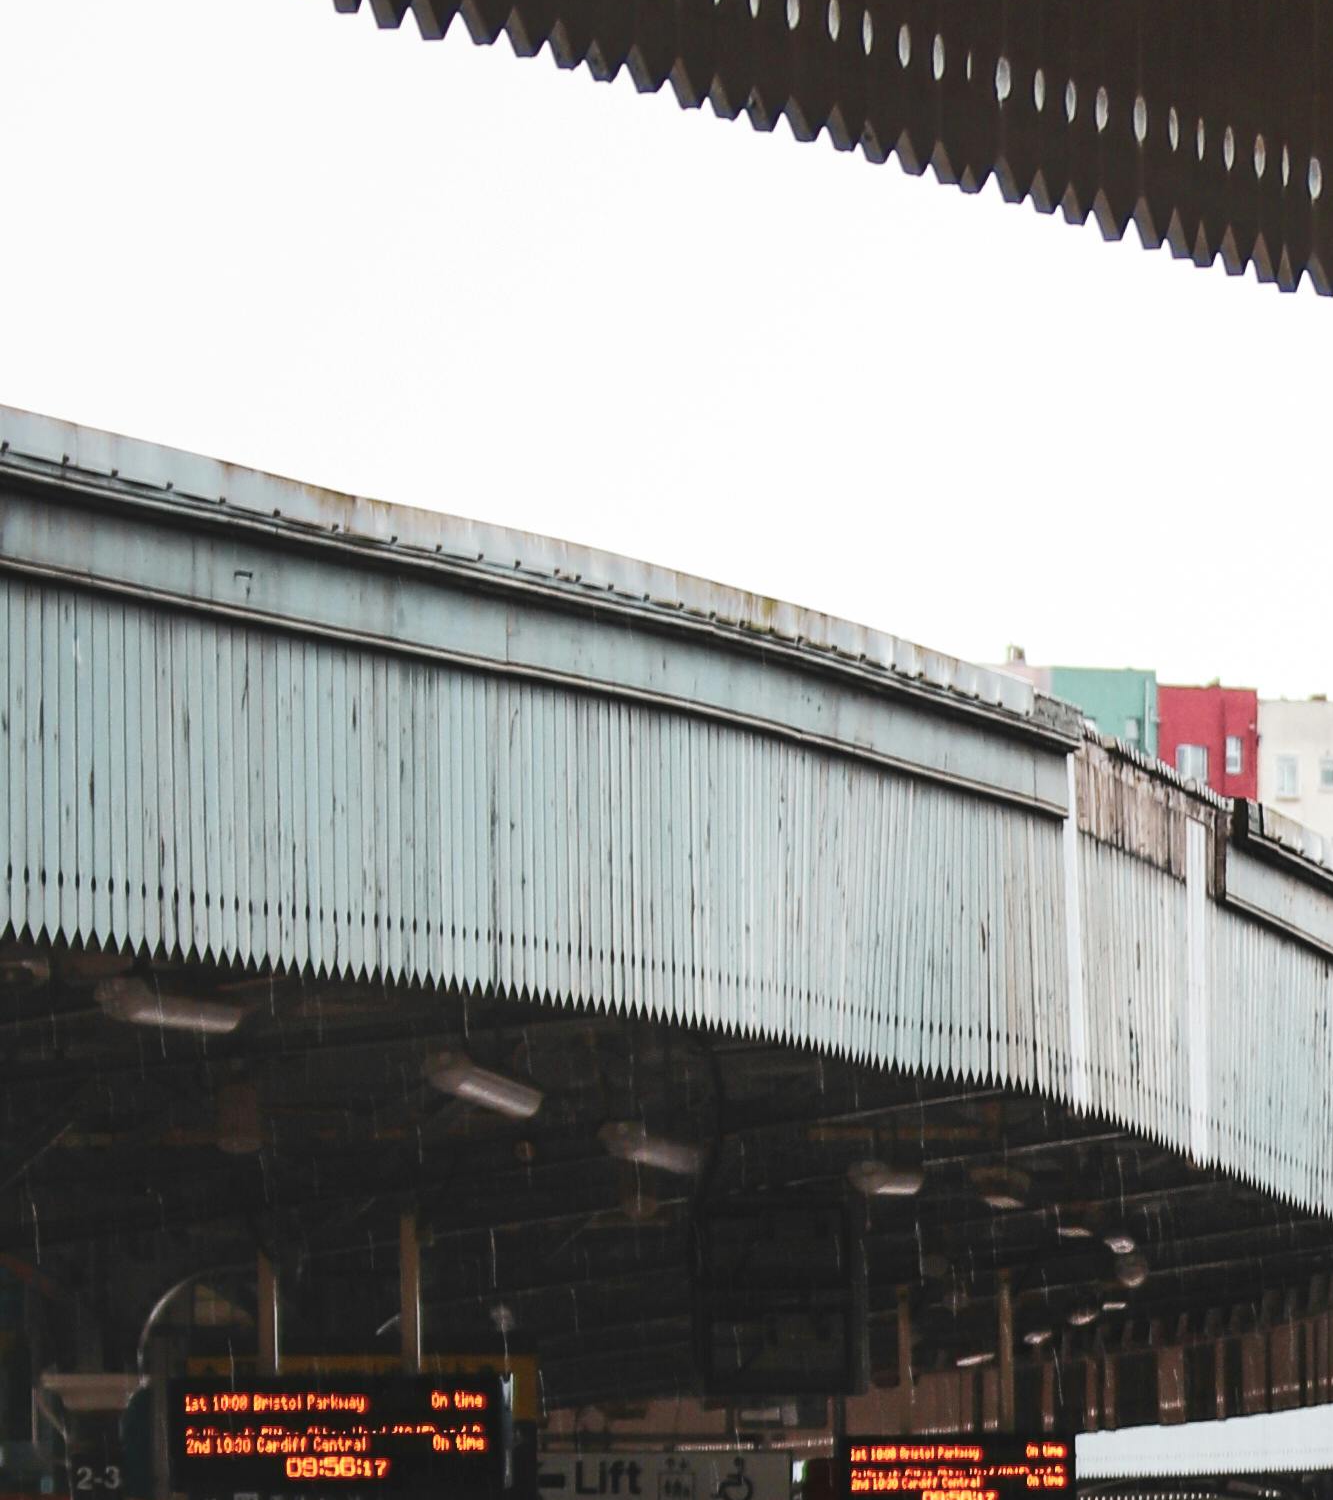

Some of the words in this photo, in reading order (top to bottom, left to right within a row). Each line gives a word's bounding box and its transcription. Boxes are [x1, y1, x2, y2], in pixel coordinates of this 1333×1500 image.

[254, 1394, 301, 1411] Bristol
[307, 1394, 365, 1413] Parkway
[432, 1392, 448, 1408] On
[455, 1391, 482, 1408] time
[186, 1436, 210, 1453] 2nd
[257, 1435, 307, 1453] Cardiff
[314, 1435, 366, 1452] Central
[433, 1434, 449, 1450] On
[456, 1434, 484, 1450] time
[77, 1466, 121, 1490] 2-3
[576, 1461, 641, 1494] Lift
